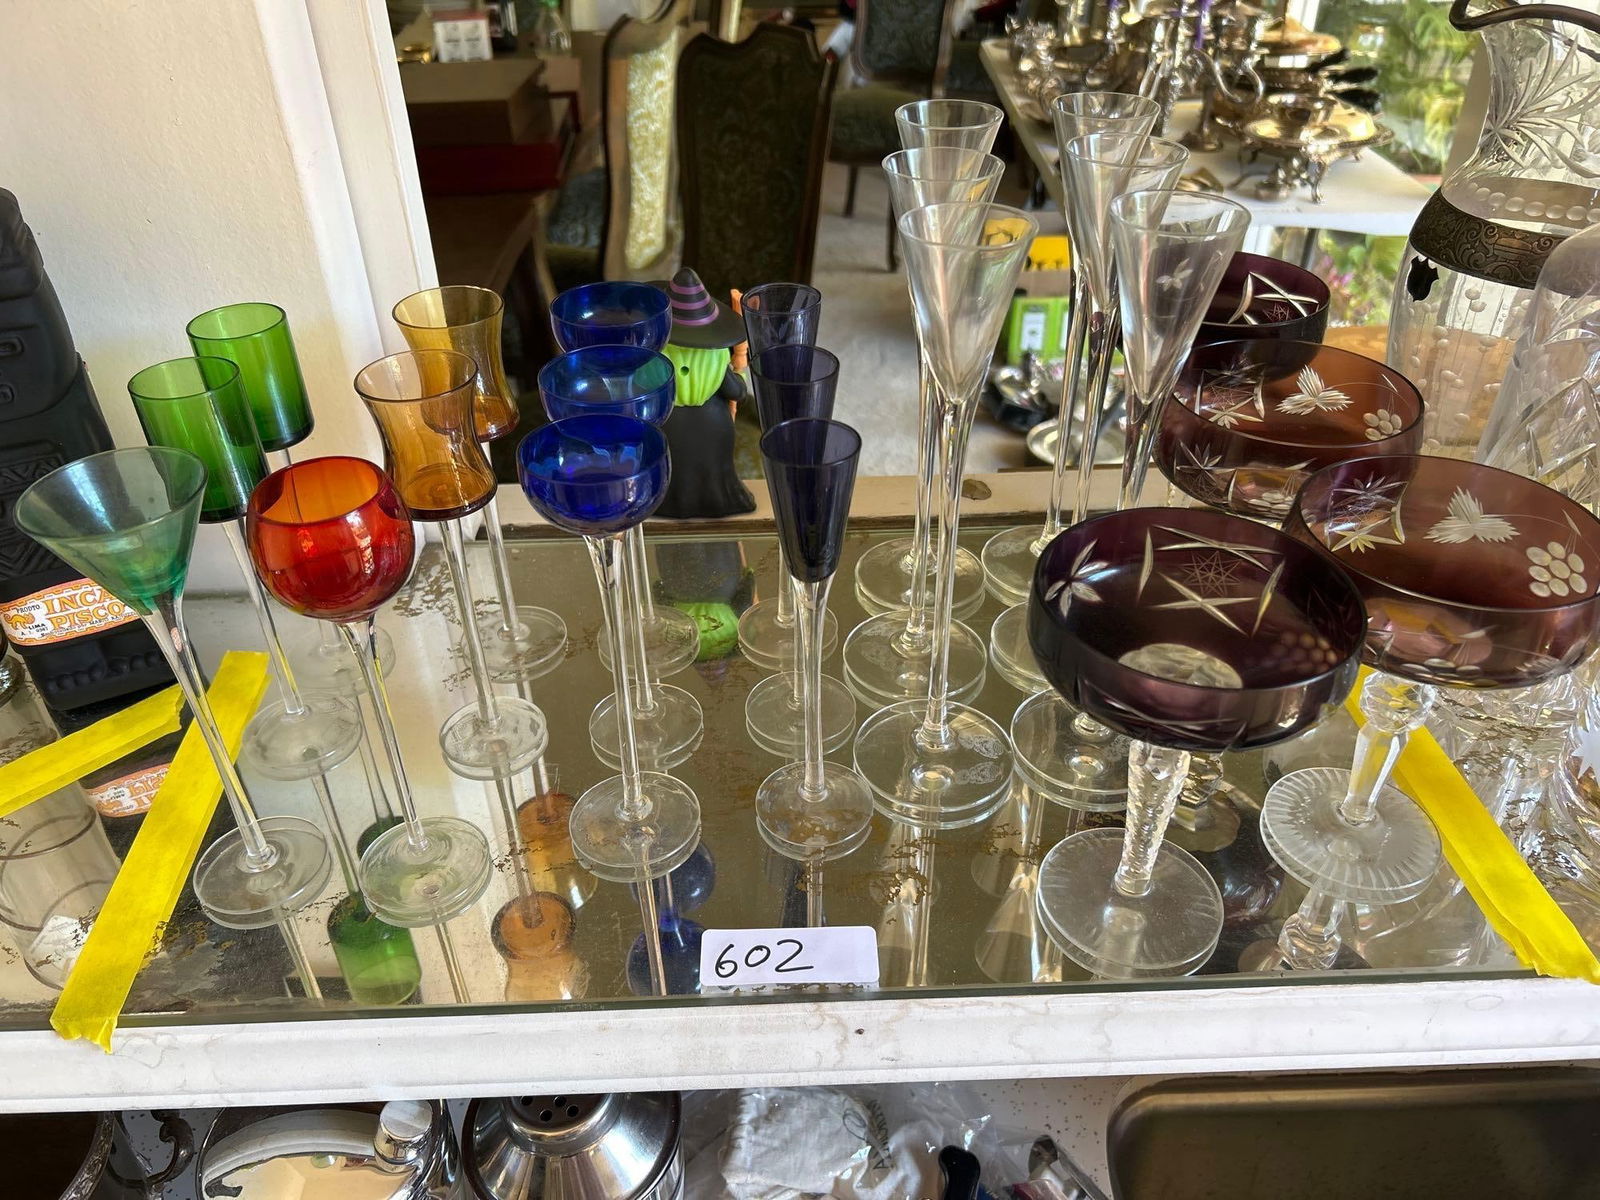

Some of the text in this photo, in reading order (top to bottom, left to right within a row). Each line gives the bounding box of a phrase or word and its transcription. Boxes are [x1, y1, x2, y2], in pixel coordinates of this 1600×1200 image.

[43, 588, 116, 615] INCA
[46, 601, 126, 631] PISCO
[714, 938, 814, 978] 602
